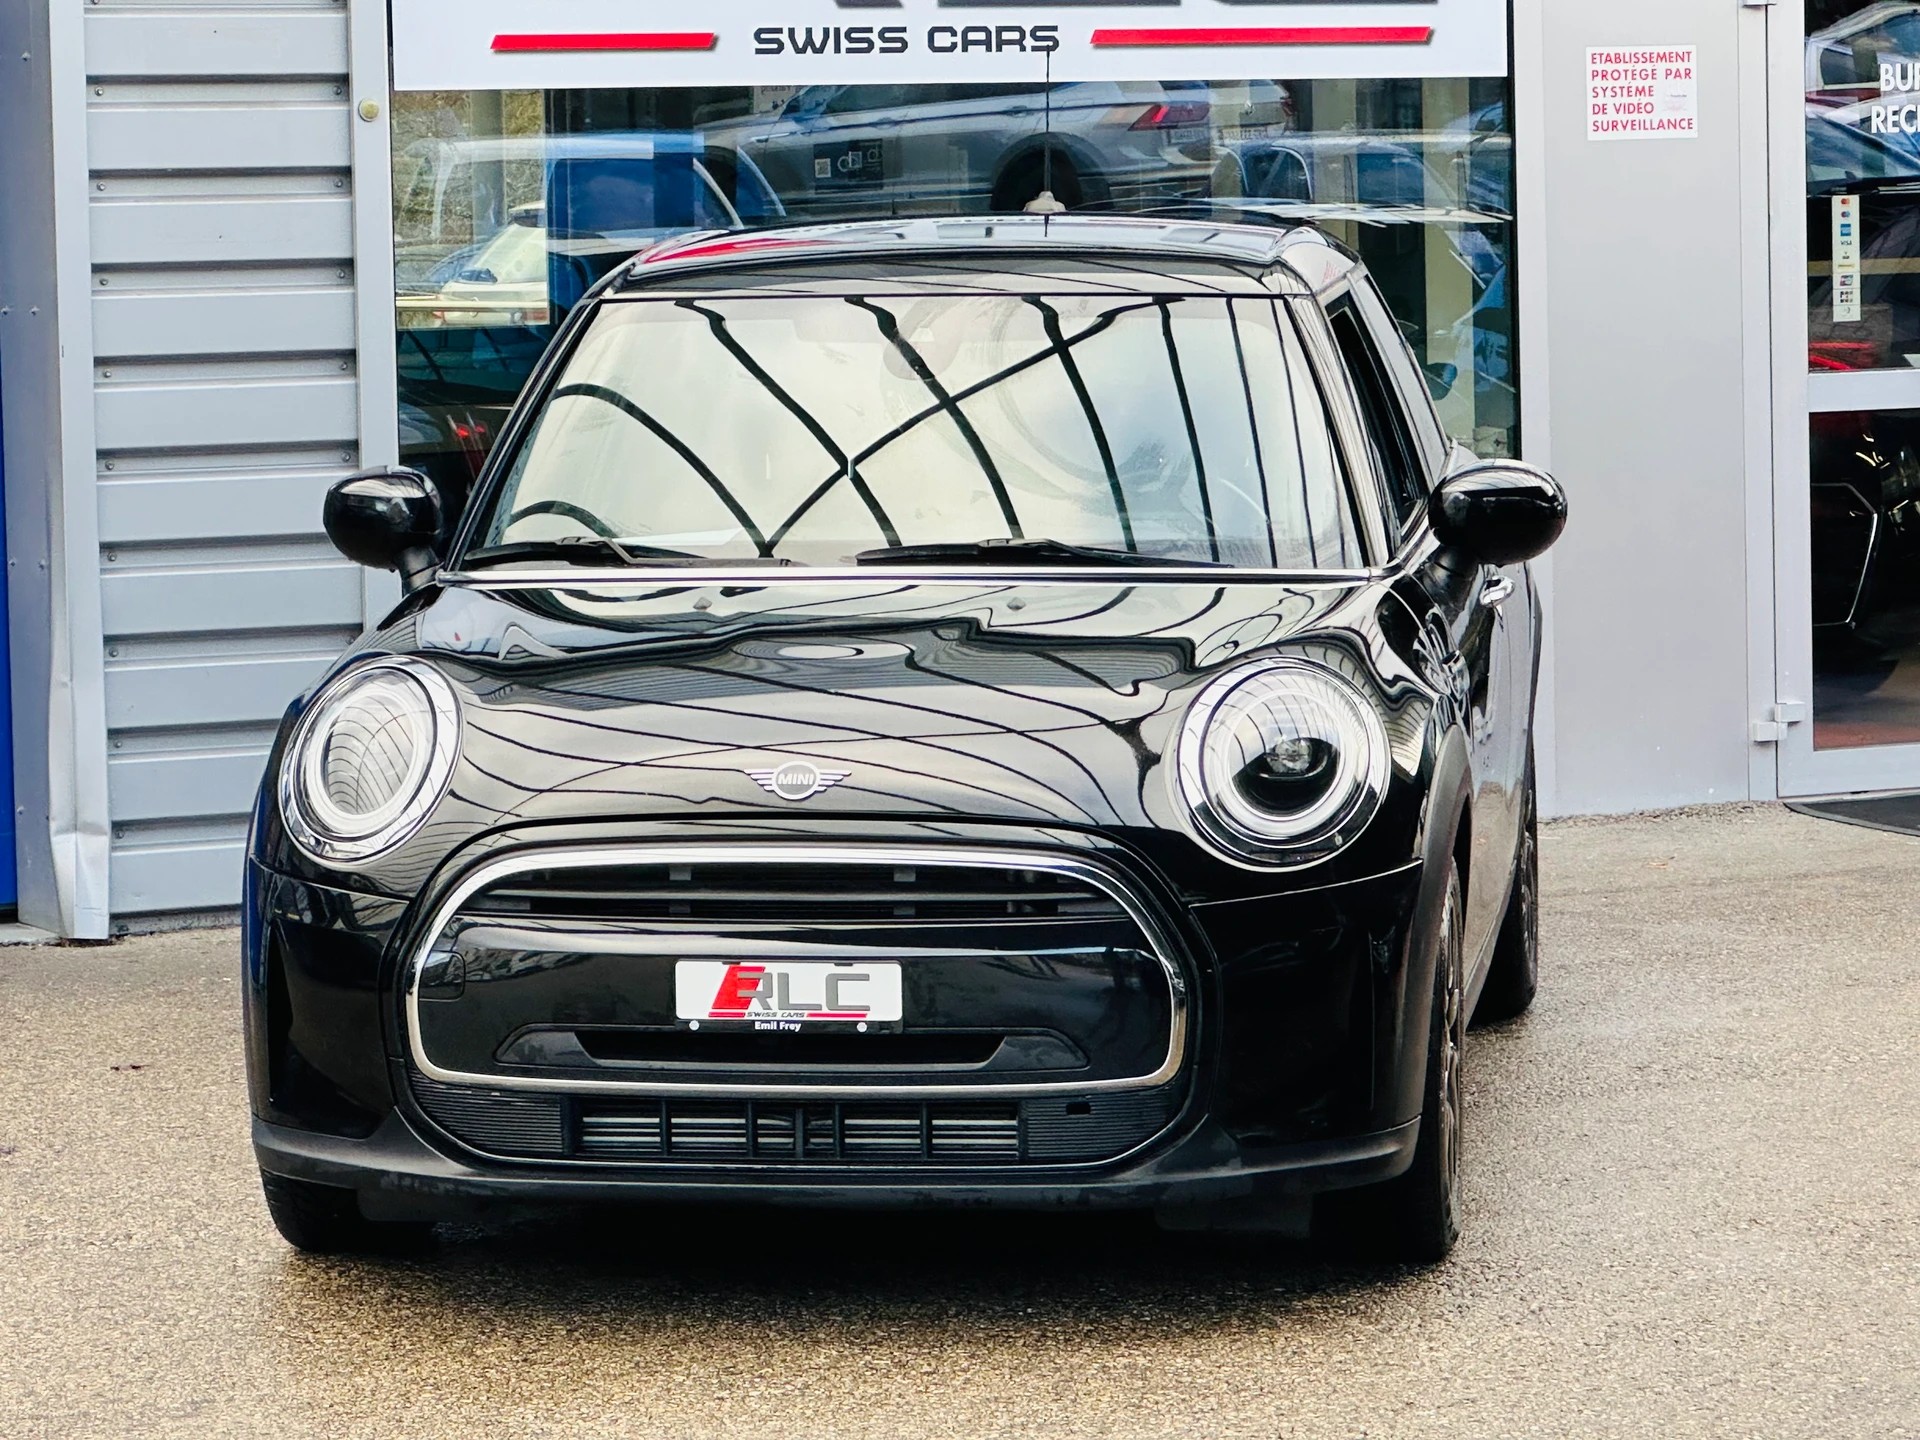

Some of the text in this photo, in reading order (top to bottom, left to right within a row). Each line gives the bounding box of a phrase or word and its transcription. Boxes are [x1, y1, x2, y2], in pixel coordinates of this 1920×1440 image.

[754, 25, 1060, 54] SWISS CARS
[1590, 51, 1692, 64] ETABLISSEMENT
[1591, 64, 1692, 81] PROTÉGÉ PAR
[1592, 103, 1608, 115] DE
[1592, 118, 1694, 132] SURVEILLANCE
[1871, 104, 1920, 133] REC
[777, 773, 815, 785] MINI
[754, 1020, 802, 1033] Emil Frey
